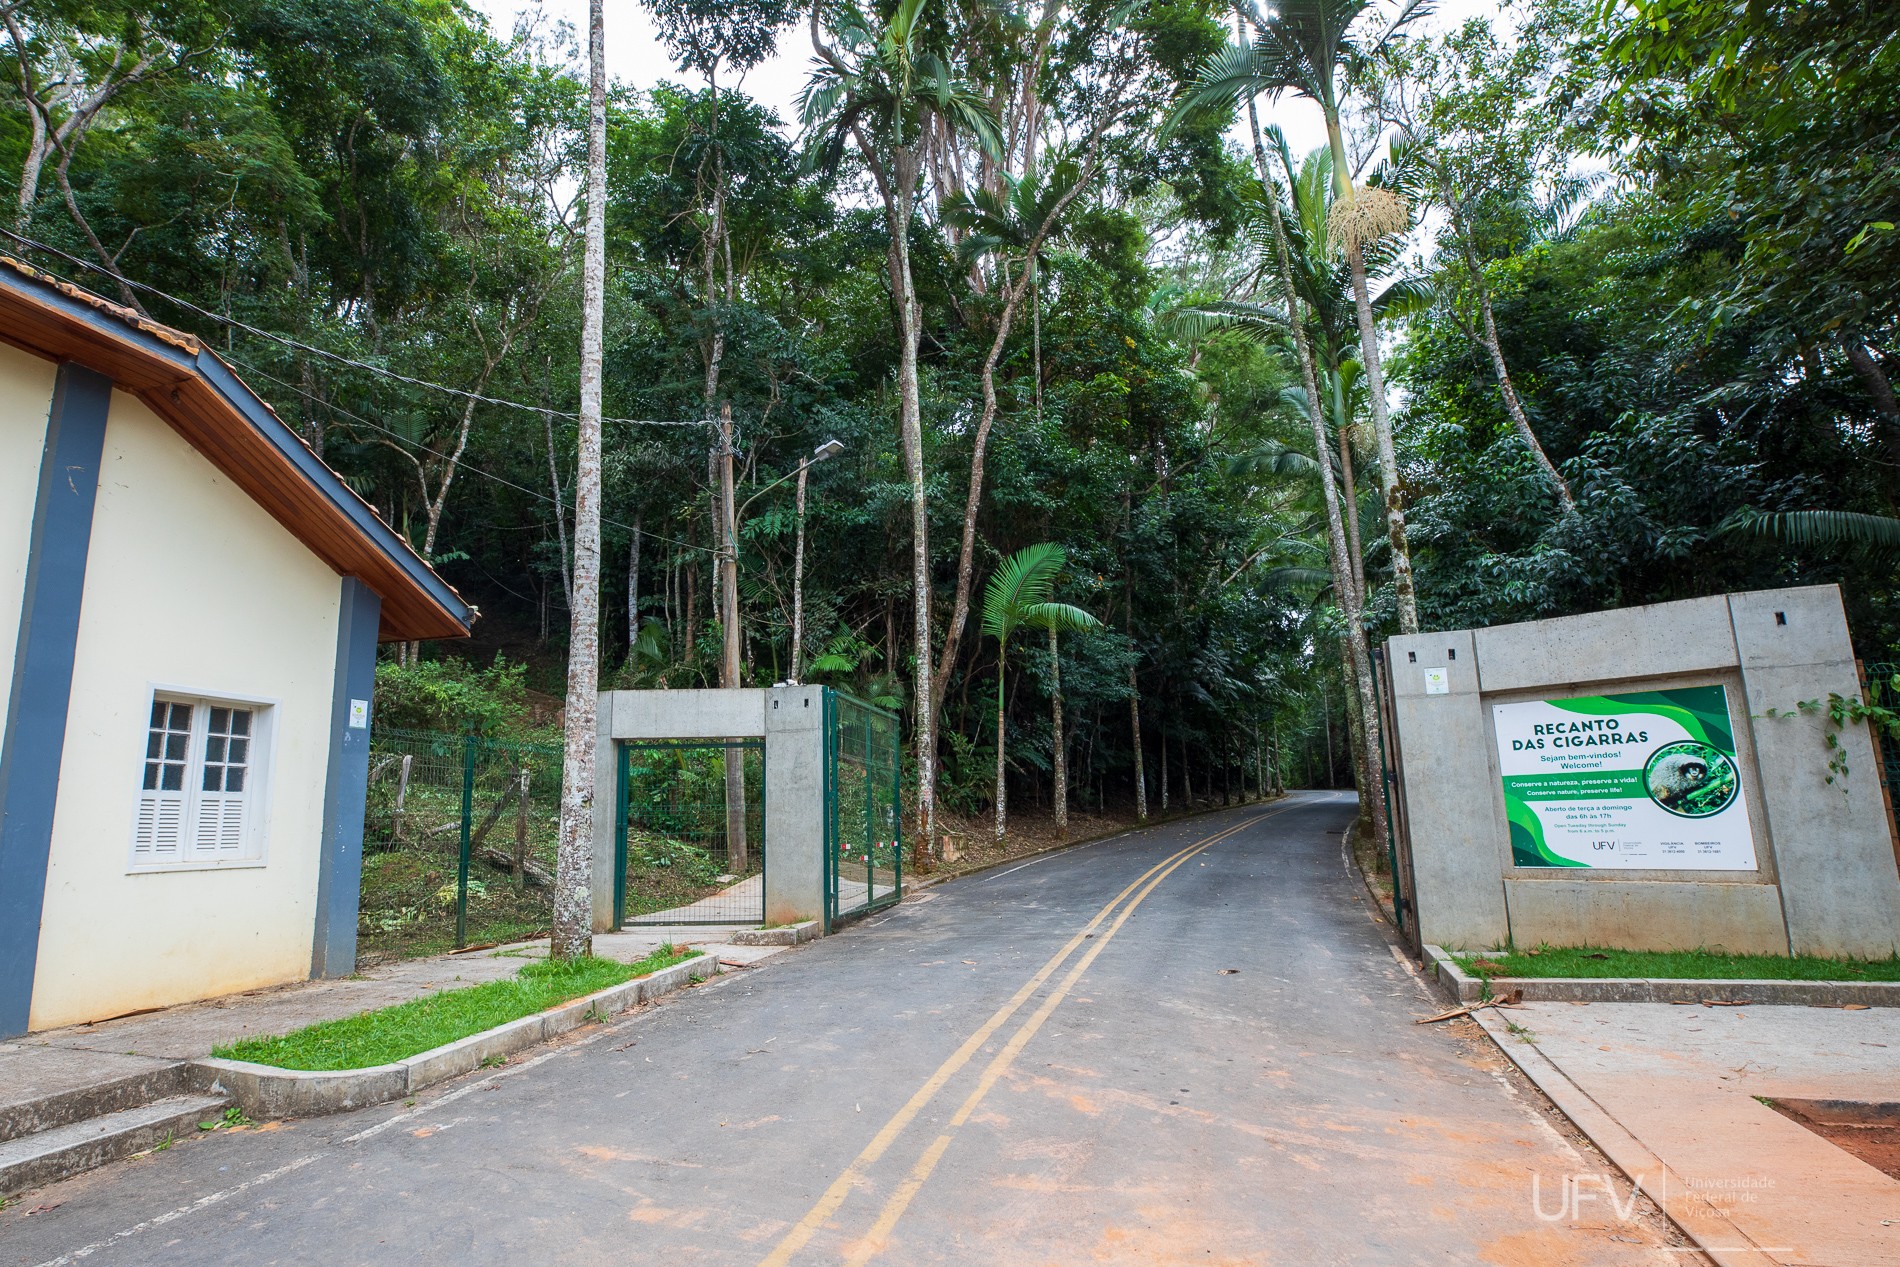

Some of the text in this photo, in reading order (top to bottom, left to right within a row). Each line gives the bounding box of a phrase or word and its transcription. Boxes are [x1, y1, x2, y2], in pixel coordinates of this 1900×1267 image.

[1534, 719, 1619, 735] RECANTO
[1513, 731, 1648, 751] DAS CIGARRAS
[1540, 751, 1621, 762] Sejam bem-vindos!
[1561, 761, 1602, 769] Welcome!
[1593, 842, 1615, 850] UFV
